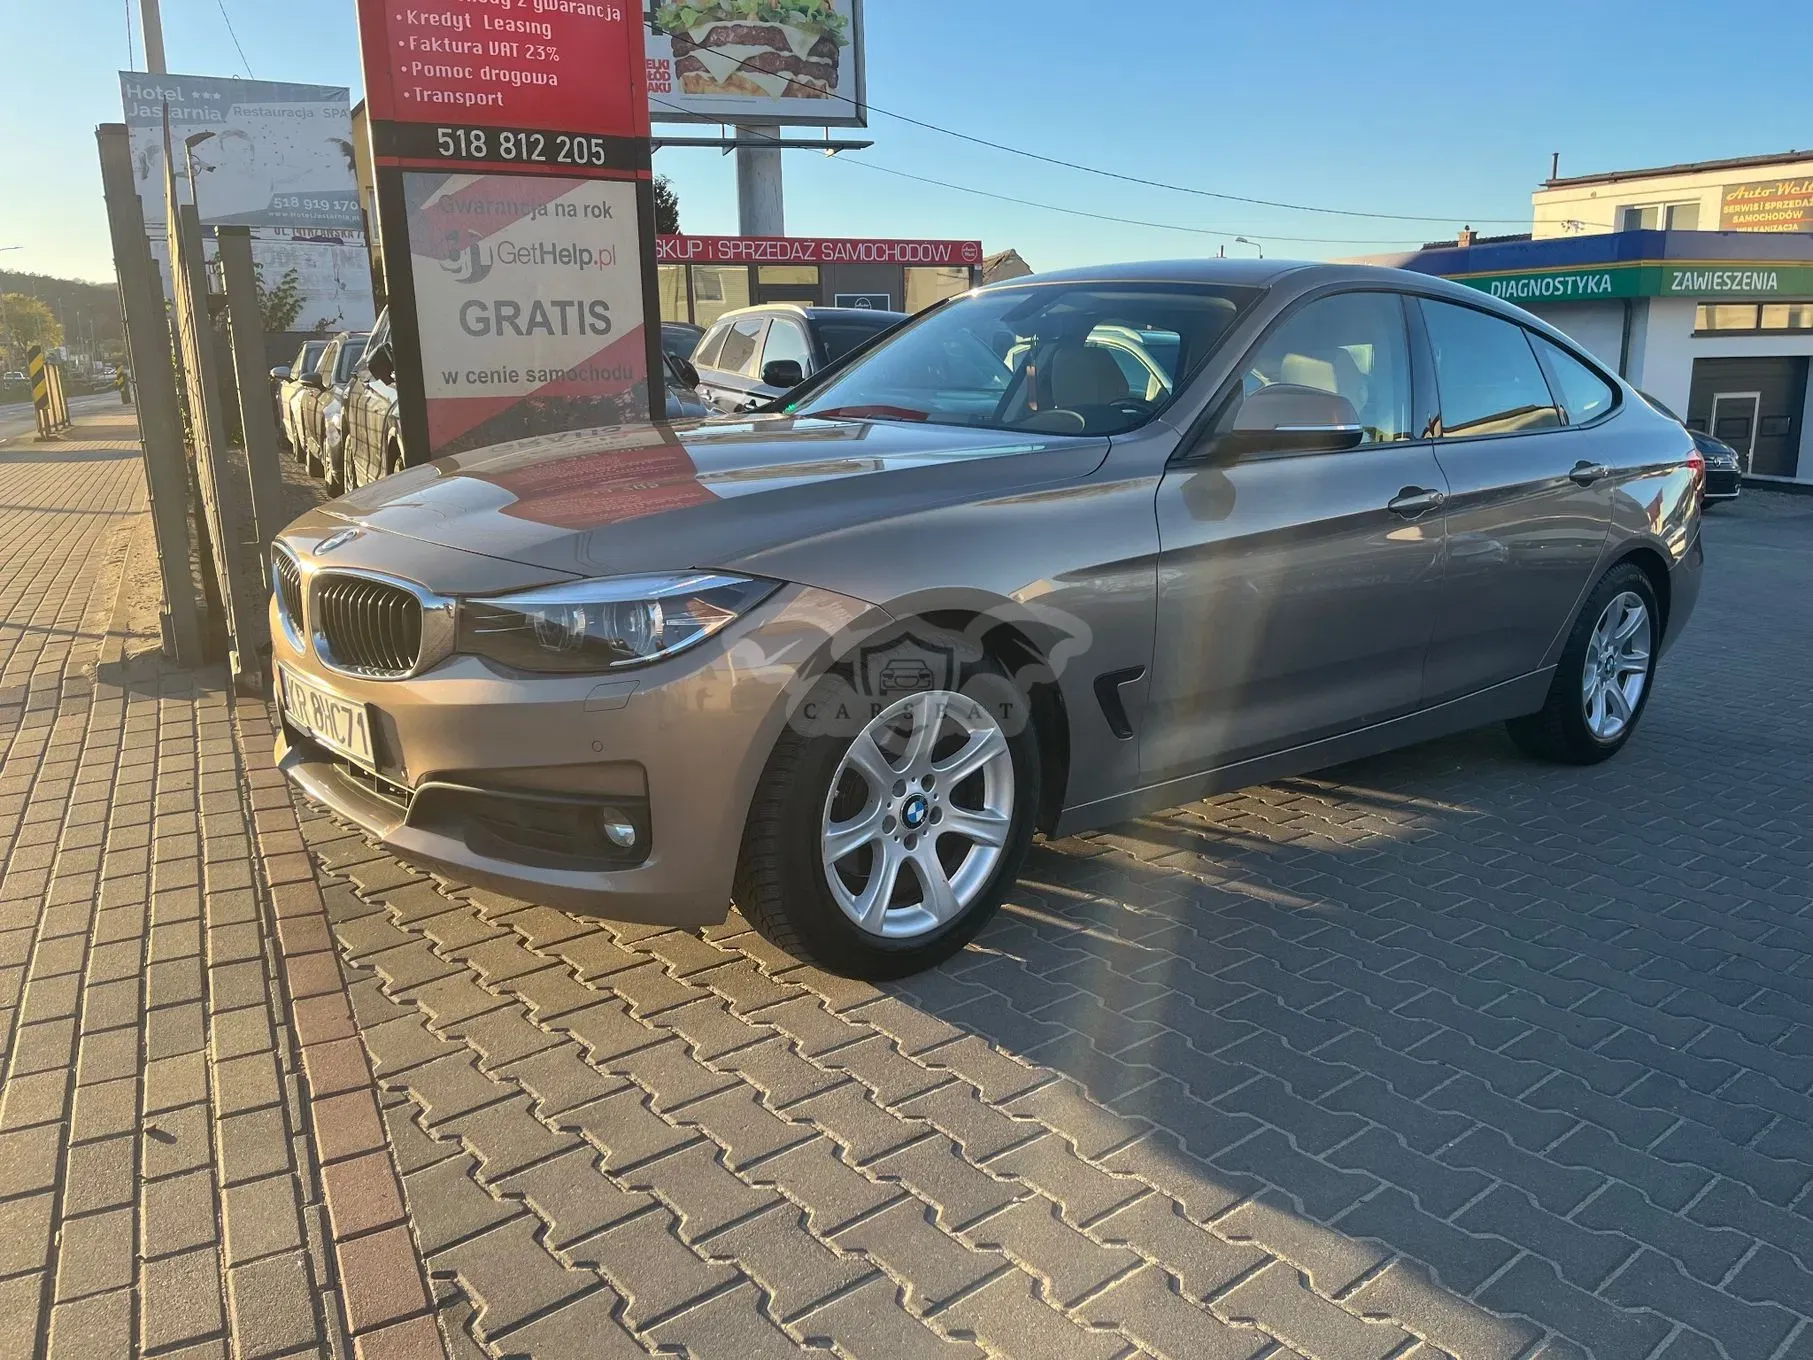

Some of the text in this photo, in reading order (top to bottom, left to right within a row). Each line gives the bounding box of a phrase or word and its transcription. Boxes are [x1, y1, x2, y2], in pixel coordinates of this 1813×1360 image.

[533, 0, 621, 22] gwarancją
[407, 10, 552, 39] Kredyt Leasing
[409, 36, 560, 62] Faktura VAT 23%
[412, 62, 558, 87] Pomoc drogowa
[126, 84, 184, 101] Hotel
[413, 87, 504, 107] Transport
[129, 102, 222, 121] Jasarnia
[233, 106, 314, 119] Restauracja
[437, 128, 605, 165] 518 812 205
[1726, 186, 1775, 200] Auto
[273, 197, 358, 212] 518 919 170
[438, 194, 613, 221] Gwarancja na rok
[1723, 203, 1760, 214] SERWIS
[1732, 210, 1804, 224] SAMOCHODÓW
[497, 240, 617, 271] GetHelp.pl
[656, 239, 702, 259] SKUP
[708, 240, 712, 259] i
[718, 239, 816, 260] SPRZEDAŻ
[821, 241, 951, 262] SAMOCHODÓW
[1490, 274, 1612, 298] DIAGNOSTYKA
[1671, 271, 1778, 291] ZAWIESZENIA
[459, 299, 612, 337] GRATIS
[442, 364, 634, 385] w cenie samochodu
[310, 691, 369, 756] 8HC71
